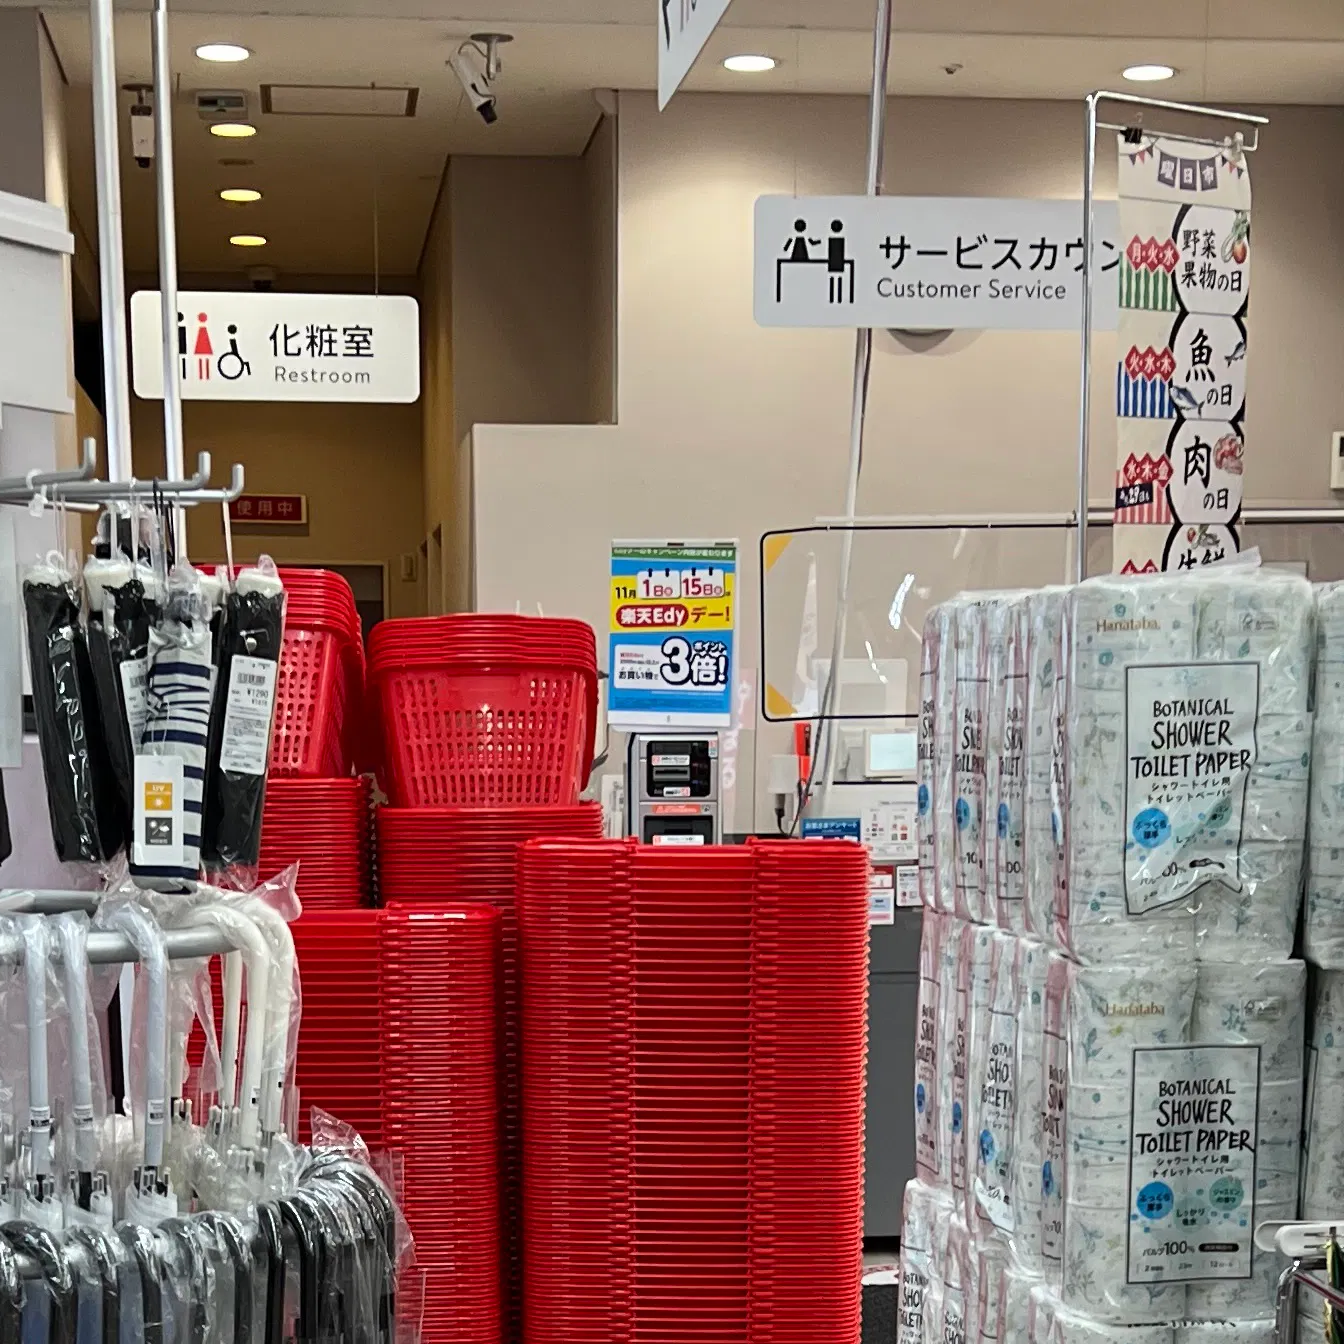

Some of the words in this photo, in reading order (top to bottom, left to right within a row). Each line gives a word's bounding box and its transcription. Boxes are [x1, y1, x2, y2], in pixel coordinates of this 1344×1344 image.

[1181, 228, 1217, 260] 野菜
[876, 276, 982, 300] Customer
[987, 277, 1067, 300] Service
[1180, 260, 1243, 294] 果物の日
[268, 322, 375, 359] 化粧室
[1186, 328, 1216, 383] 魚
[274, 365, 371, 385] Restroom
[1207, 383, 1233, 407] の日
[1183, 434, 1213, 489] 肉
[236, 497, 296, 517] 使用中
[1202, 487, 1230, 511] の日
[615, 585, 637, 600] 11月
[619, 606, 686, 627] 楽天Edy
[1153, 698, 1235, 719] BOTANICAL
[1151, 719, 1234, 751] SHOWER
[1130, 753, 1191, 779] TOILET
[1193, 749, 1252, 778] PAPER
[1158, 1077, 1237, 1098] BOTANICAL
[1155, 1098, 1235, 1128] SHOWER
[1135, 1129, 1192, 1156] TOILET
[1195, 1128, 1255, 1154] PAPER
